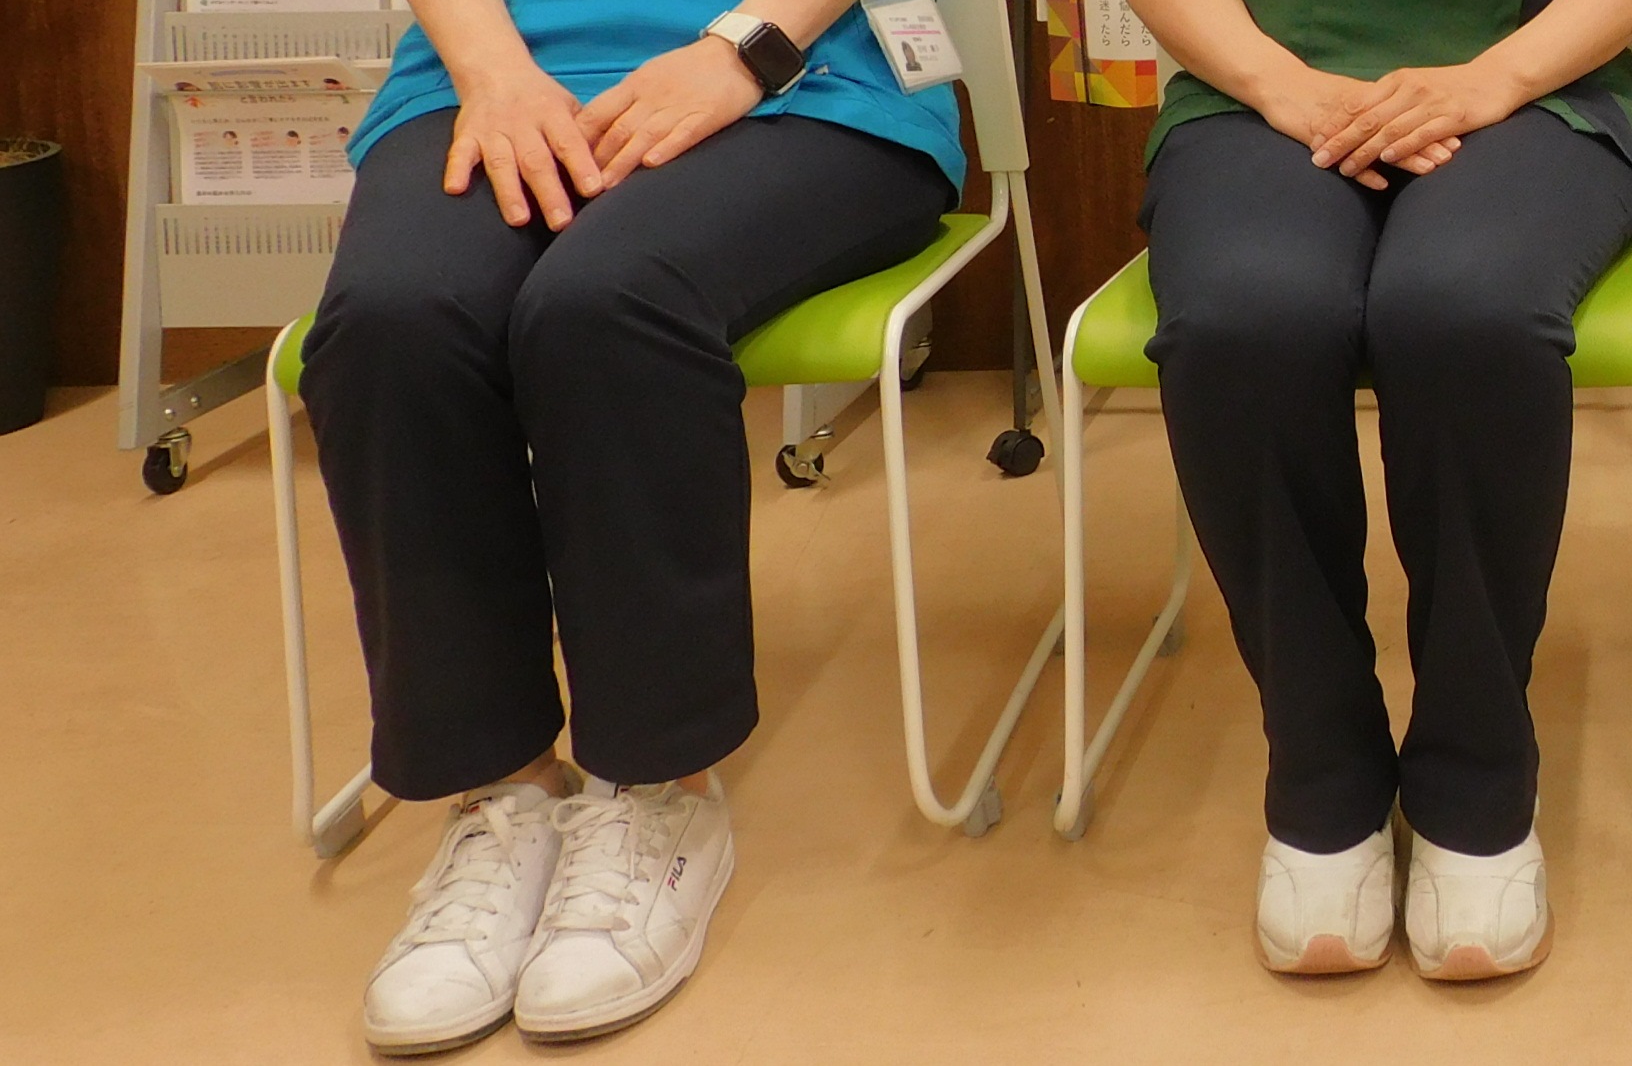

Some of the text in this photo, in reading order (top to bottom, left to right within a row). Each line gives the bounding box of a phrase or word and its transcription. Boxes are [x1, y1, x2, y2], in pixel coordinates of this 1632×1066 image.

[1100, 0, 1111, 47] 迷ったら
[666, 855, 688, 892] FILA
